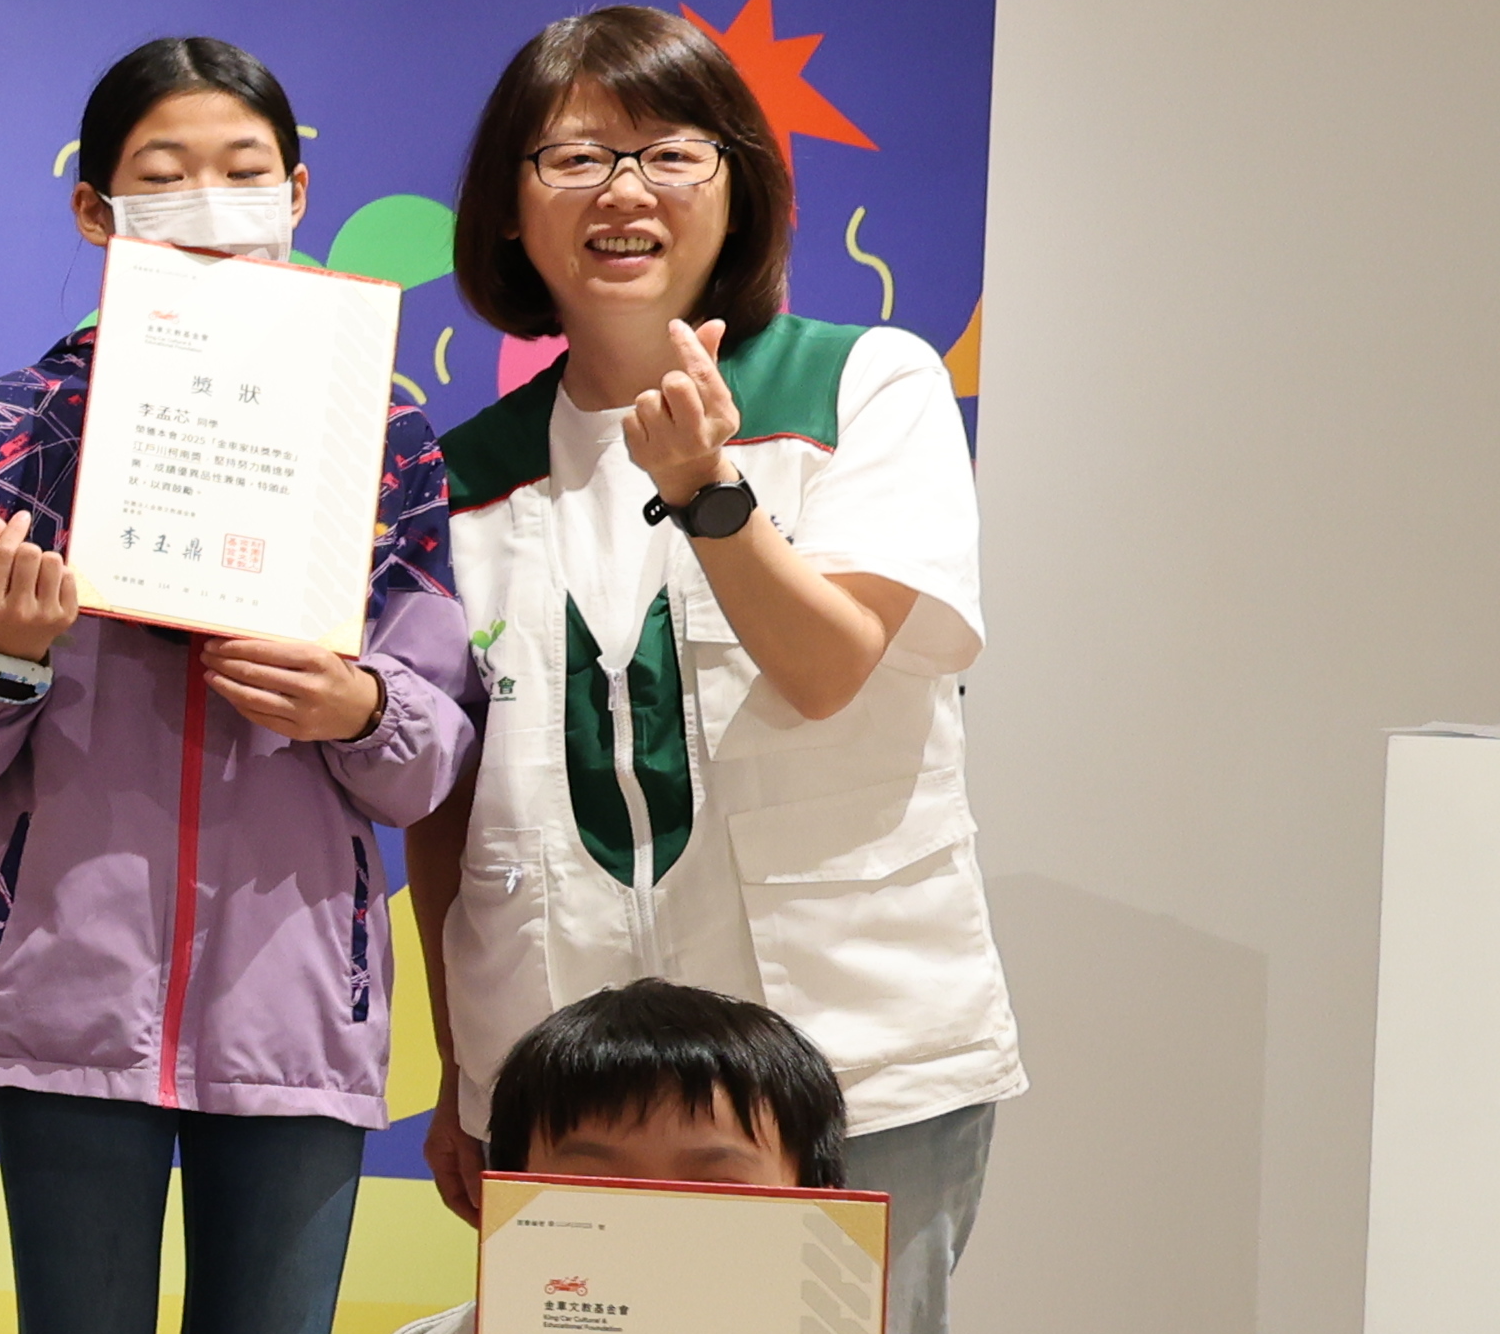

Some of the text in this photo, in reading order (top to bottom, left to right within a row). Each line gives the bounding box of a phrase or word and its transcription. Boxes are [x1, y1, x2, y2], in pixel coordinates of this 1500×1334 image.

[544, 1300, 629, 1315] 金車文教基金會
